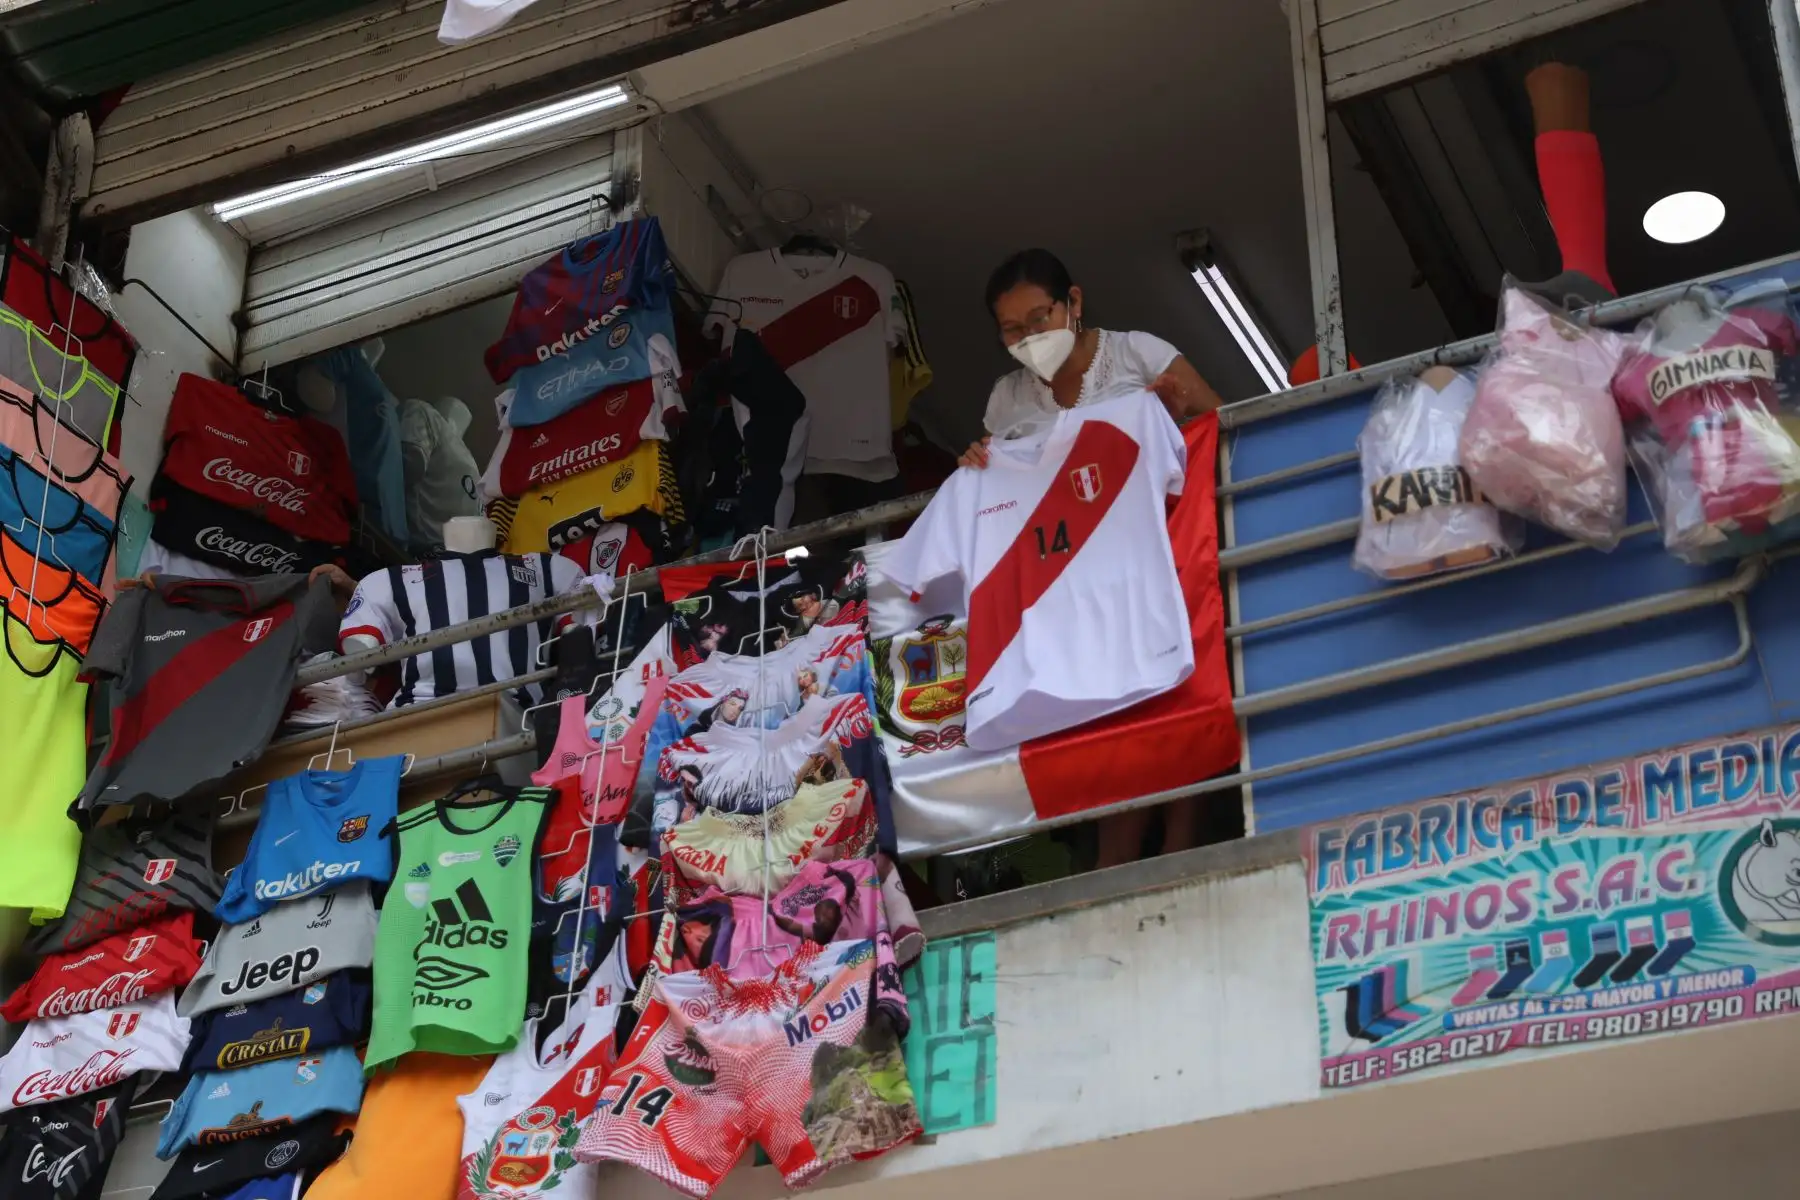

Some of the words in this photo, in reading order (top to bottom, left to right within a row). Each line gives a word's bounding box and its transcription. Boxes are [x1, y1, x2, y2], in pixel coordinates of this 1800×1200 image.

[537, 356, 631, 401] ETIHAD
[1650, 348, 1768, 400] GIMNACIA
[205, 424, 249, 447] marathon
[528, 433, 622, 482] Emirates
[976, 500, 1018, 517] marathon
[1034, 519, 1072, 559] 14
[144, 629, 186, 643] marathon
[1316, 789, 1533, 893] FABRICA
[1555, 770, 1624, 835] DE
[255, 860, 361, 901] Rakuten
[307, 918, 332, 930] Jeep
[1325, 878, 1532, 960] RHINOS
[1552, 849, 1698, 914] S.A.C.
[61, 952, 105, 971] marathon
[221, 946, 320, 996] Jeep
[783, 987, 862, 1048] Mobil
[1453, 1002, 1519, 1027] VENTAS
[1524, 1000, 1544, 1016] AL
[1550, 993, 1588, 1012] POR
[1592, 983, 1656, 1008] MAYOR
[1660, 980, 1672, 997] Y
[1678, 968, 1744, 994] MENOR
[32, 1032, 73, 1049] marathon
[226, 1032, 300, 1064] CRISTAL
[634, 1025, 650, 1042] F
[1325, 1056, 1387, 1086] TELF:
[1392, 1029, 1513, 1073] 582-0217
[1528, 1021, 1580, 1044] CEL:
[1587, 996, 1744, 1039] 980319790
[663, 1041, 720, 1072] Pilsen
[611, 1073, 675, 1127] 14
